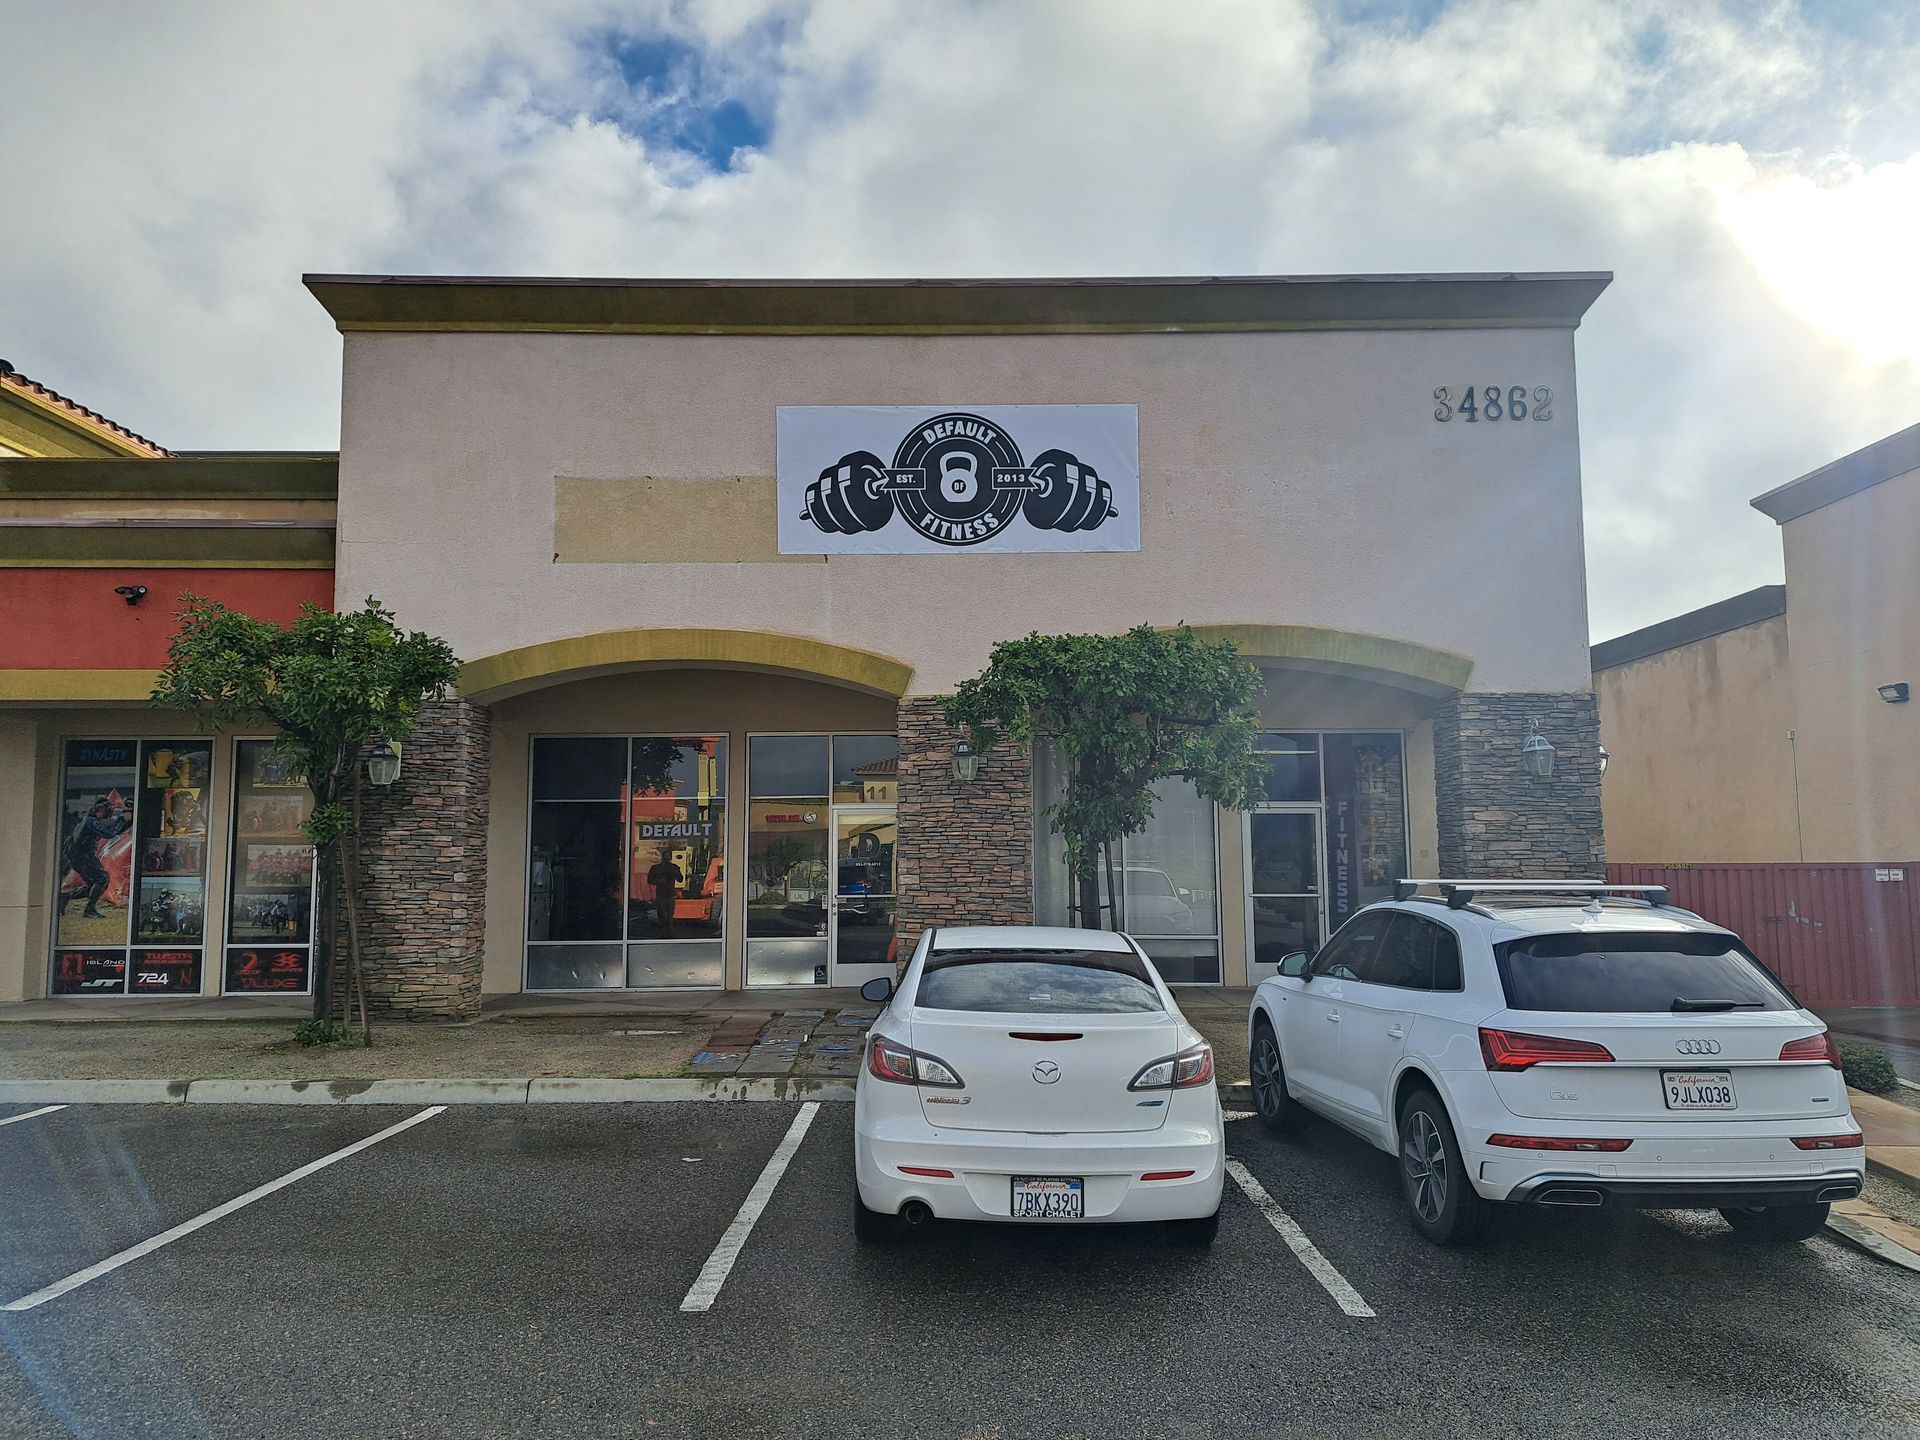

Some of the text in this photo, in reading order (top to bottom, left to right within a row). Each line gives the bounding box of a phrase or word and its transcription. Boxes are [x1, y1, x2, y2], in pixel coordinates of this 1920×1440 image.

[1434, 385, 1553, 422] 34862
[922, 420, 997, 445] DEFAULT
[896, 474, 916, 484] EST.
[997, 474, 1025, 483] 2013
[953, 482, 965, 491] DF
[920, 512, 999, 540] FITNESS
[80, 747, 128, 761] DYNASTY
[642, 823, 712, 838] DEFAULT
[1336, 801, 1348, 914] FITNESS
[137, 972, 169, 985] 724
[1677, 1075, 1720, 1086] California
[1671, 1086, 1731, 1104] 9JLX038
[1026, 1181, 1067, 1192] California
[1016, 1192, 1079, 1212] 7BKX390
[1013, 1210, 1081, 1218] SPORT CHALET
